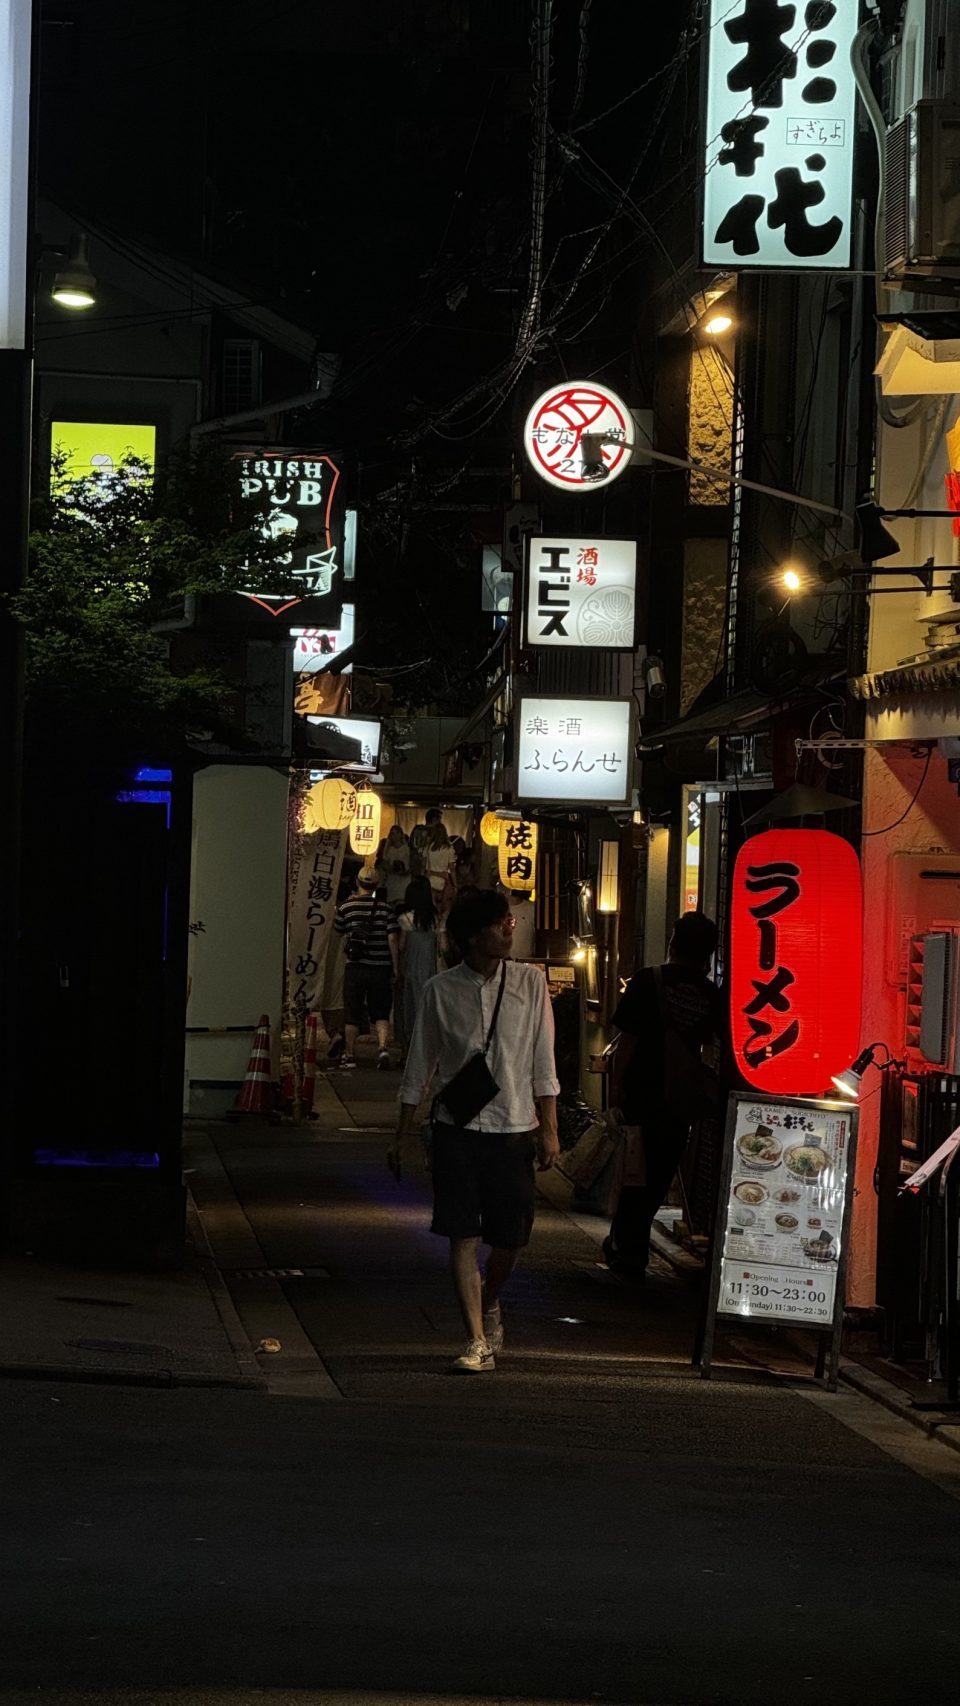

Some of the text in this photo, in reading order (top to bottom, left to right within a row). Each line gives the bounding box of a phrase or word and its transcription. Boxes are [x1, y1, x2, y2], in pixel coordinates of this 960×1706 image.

[789, 119, 841, 145] すぎちよ
[532, 427, 626, 445] もな堂
[241, 459, 322, 479] IRISH
[239, 478, 322, 506] PUB
[577, 547, 599, 587] 酒場
[538, 547, 571, 637] エビス
[524, 749, 622, 774] ふらんせ
[340, 791, 356, 813] 酒
[505, 822, 532, 880] 焼肉
[743, 862, 800, 1068] ラーメン
[750, 1273, 807, 1286] Opening Hours
